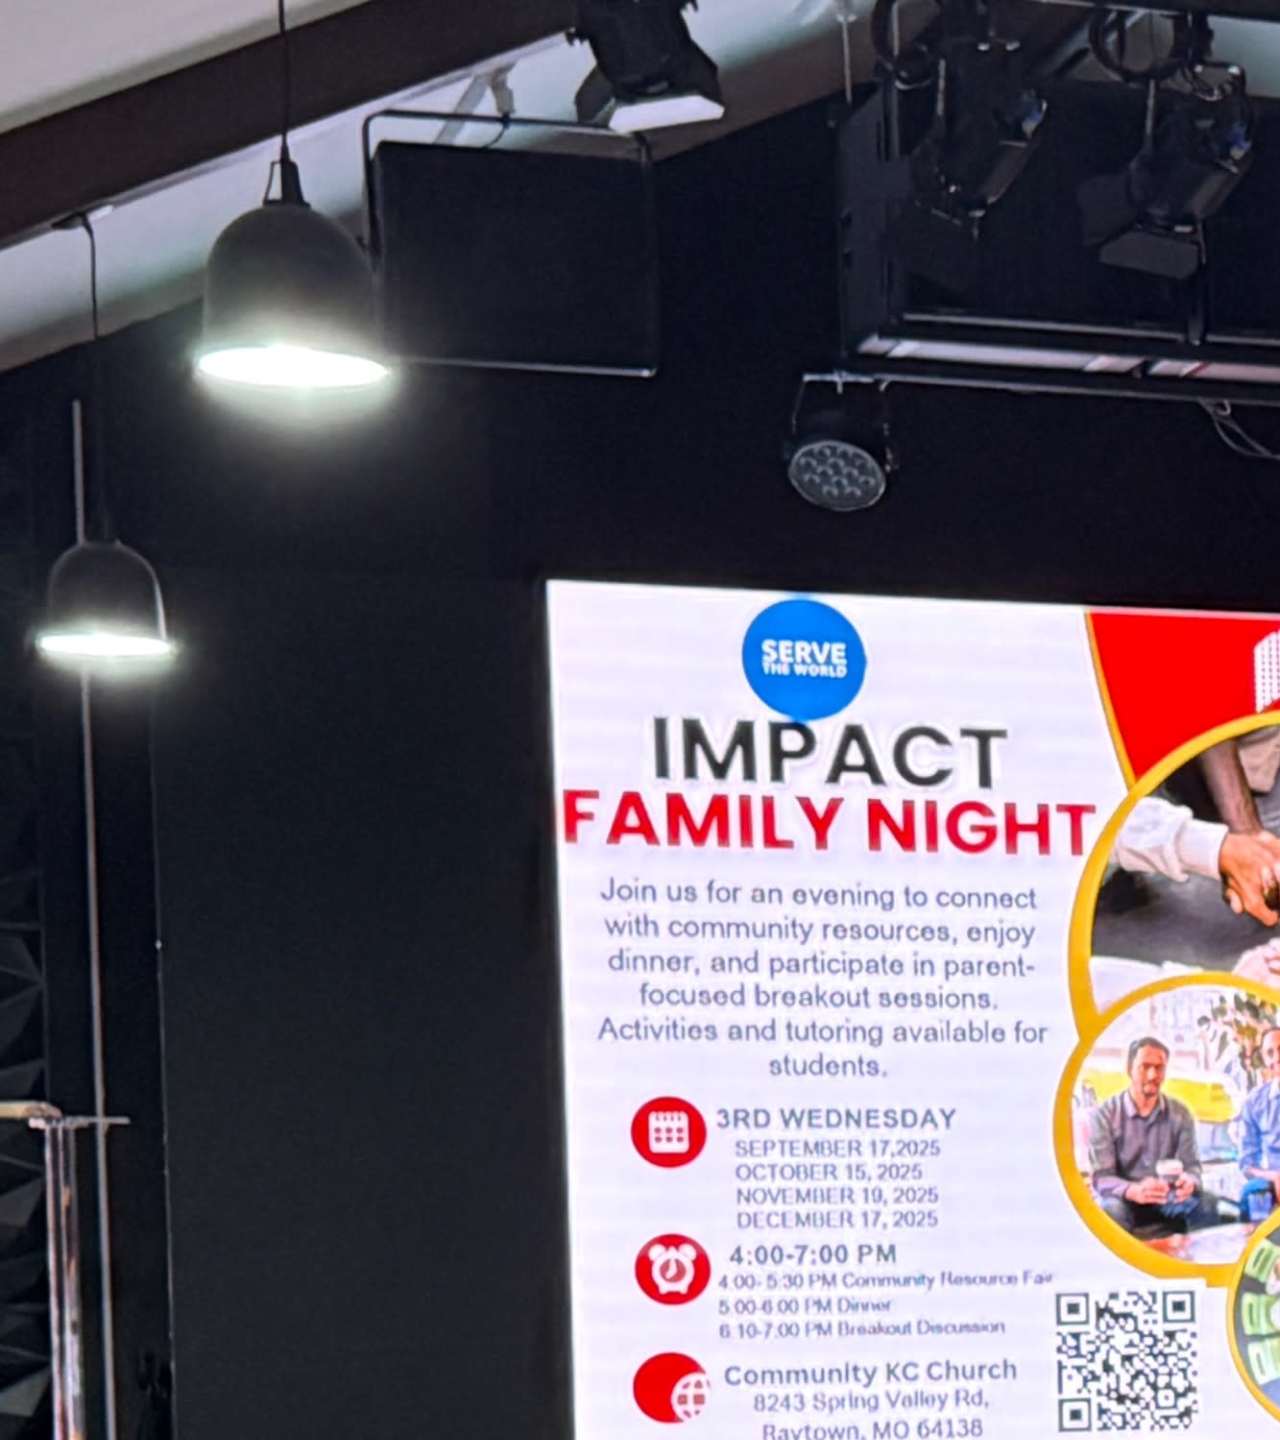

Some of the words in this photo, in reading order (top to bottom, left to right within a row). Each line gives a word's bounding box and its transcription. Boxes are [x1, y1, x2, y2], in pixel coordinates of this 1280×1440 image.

[762, 639, 846, 664] SERVE
[763, 662, 791, 676] THE
[794, 664, 848, 679] WORLD
[653, 716, 1008, 790] IMPACT
[562, 788, 844, 851] FAMILY
[867, 798, 1096, 856] NIGHT
[600, 876, 657, 903] Join
[666, 884, 698, 903] us
[707, 879, 742, 904] for
[751, 886, 783, 905] an
[792, 883, 895, 912] evening
[903, 886, 928, 908] to
[936, 888, 1037, 910] connect
[605, 912, 659, 937] with
[668, 914, 814, 945] community
[822, 922, 957, 946] resources,
[967, 919, 1036, 949] enjoy
[608, 947, 700, 976] dinner,
[711, 950, 759, 973] and
[769, 950, 904, 981] participate
[912, 951, 935, 976] in
[945, 953, 1036, 981] parent-
[640, 982, 745, 1006] focused
[754, 982, 870, 1009] breakout
[878, 985, 998, 1010] sessions.
[598, 1016, 718, 1041] Activities
[728, 1018, 777, 1041] and
[786, 1017, 883, 1047] tutoring
[893, 1020, 1006, 1043] available
[1014, 1020, 1048, 1044] for
[769, 1052, 888, 1078] students.
[716, 1108, 771, 1129] 3RD
[780, 1108, 956, 1129] WEDNESDAY
[735, 1140, 862, 1158] SEPTEMBER
[869, 1139, 941, 1160] 17,2025
[735, 1164, 838, 1181] OCTOBER
[845, 1164, 872, 1183] 15,
[877, 1163, 923, 1181] 2025
[737, 1187, 855, 1205] NOVEMBER
[893, 1186, 939, 1204] 2025
[737, 1211, 854, 1229] DECEMBER
[893, 1210, 939, 1228] 2025
[729, 1244, 849, 1266] 4:00-7:00
[857, 1244, 897, 1264] PM
[808, 1272, 837, 1288] PM
[842, 1271, 935, 1291] Community
[940, 1270, 1018, 1286] Resource
[804, 1297, 832, 1314] PM
[837, 1297, 891, 1313] Dinner
[804, 1321, 832, 1338] PM
[837, 1320, 913, 1337] Breakout
[917, 1319, 1006, 1335] Discussion
[724, 1362, 878, 1388] Community
[886, 1362, 920, 1382] KC
[926, 1358, 1018, 1382] Church
[753, 1392, 806, 1412] 8243
[812, 1388, 880, 1414] Spring
[884, 1388, 949, 1410] Valley
[872, 1421, 911, 1440] MO
[917, 1418, 984, 1438] 64138
